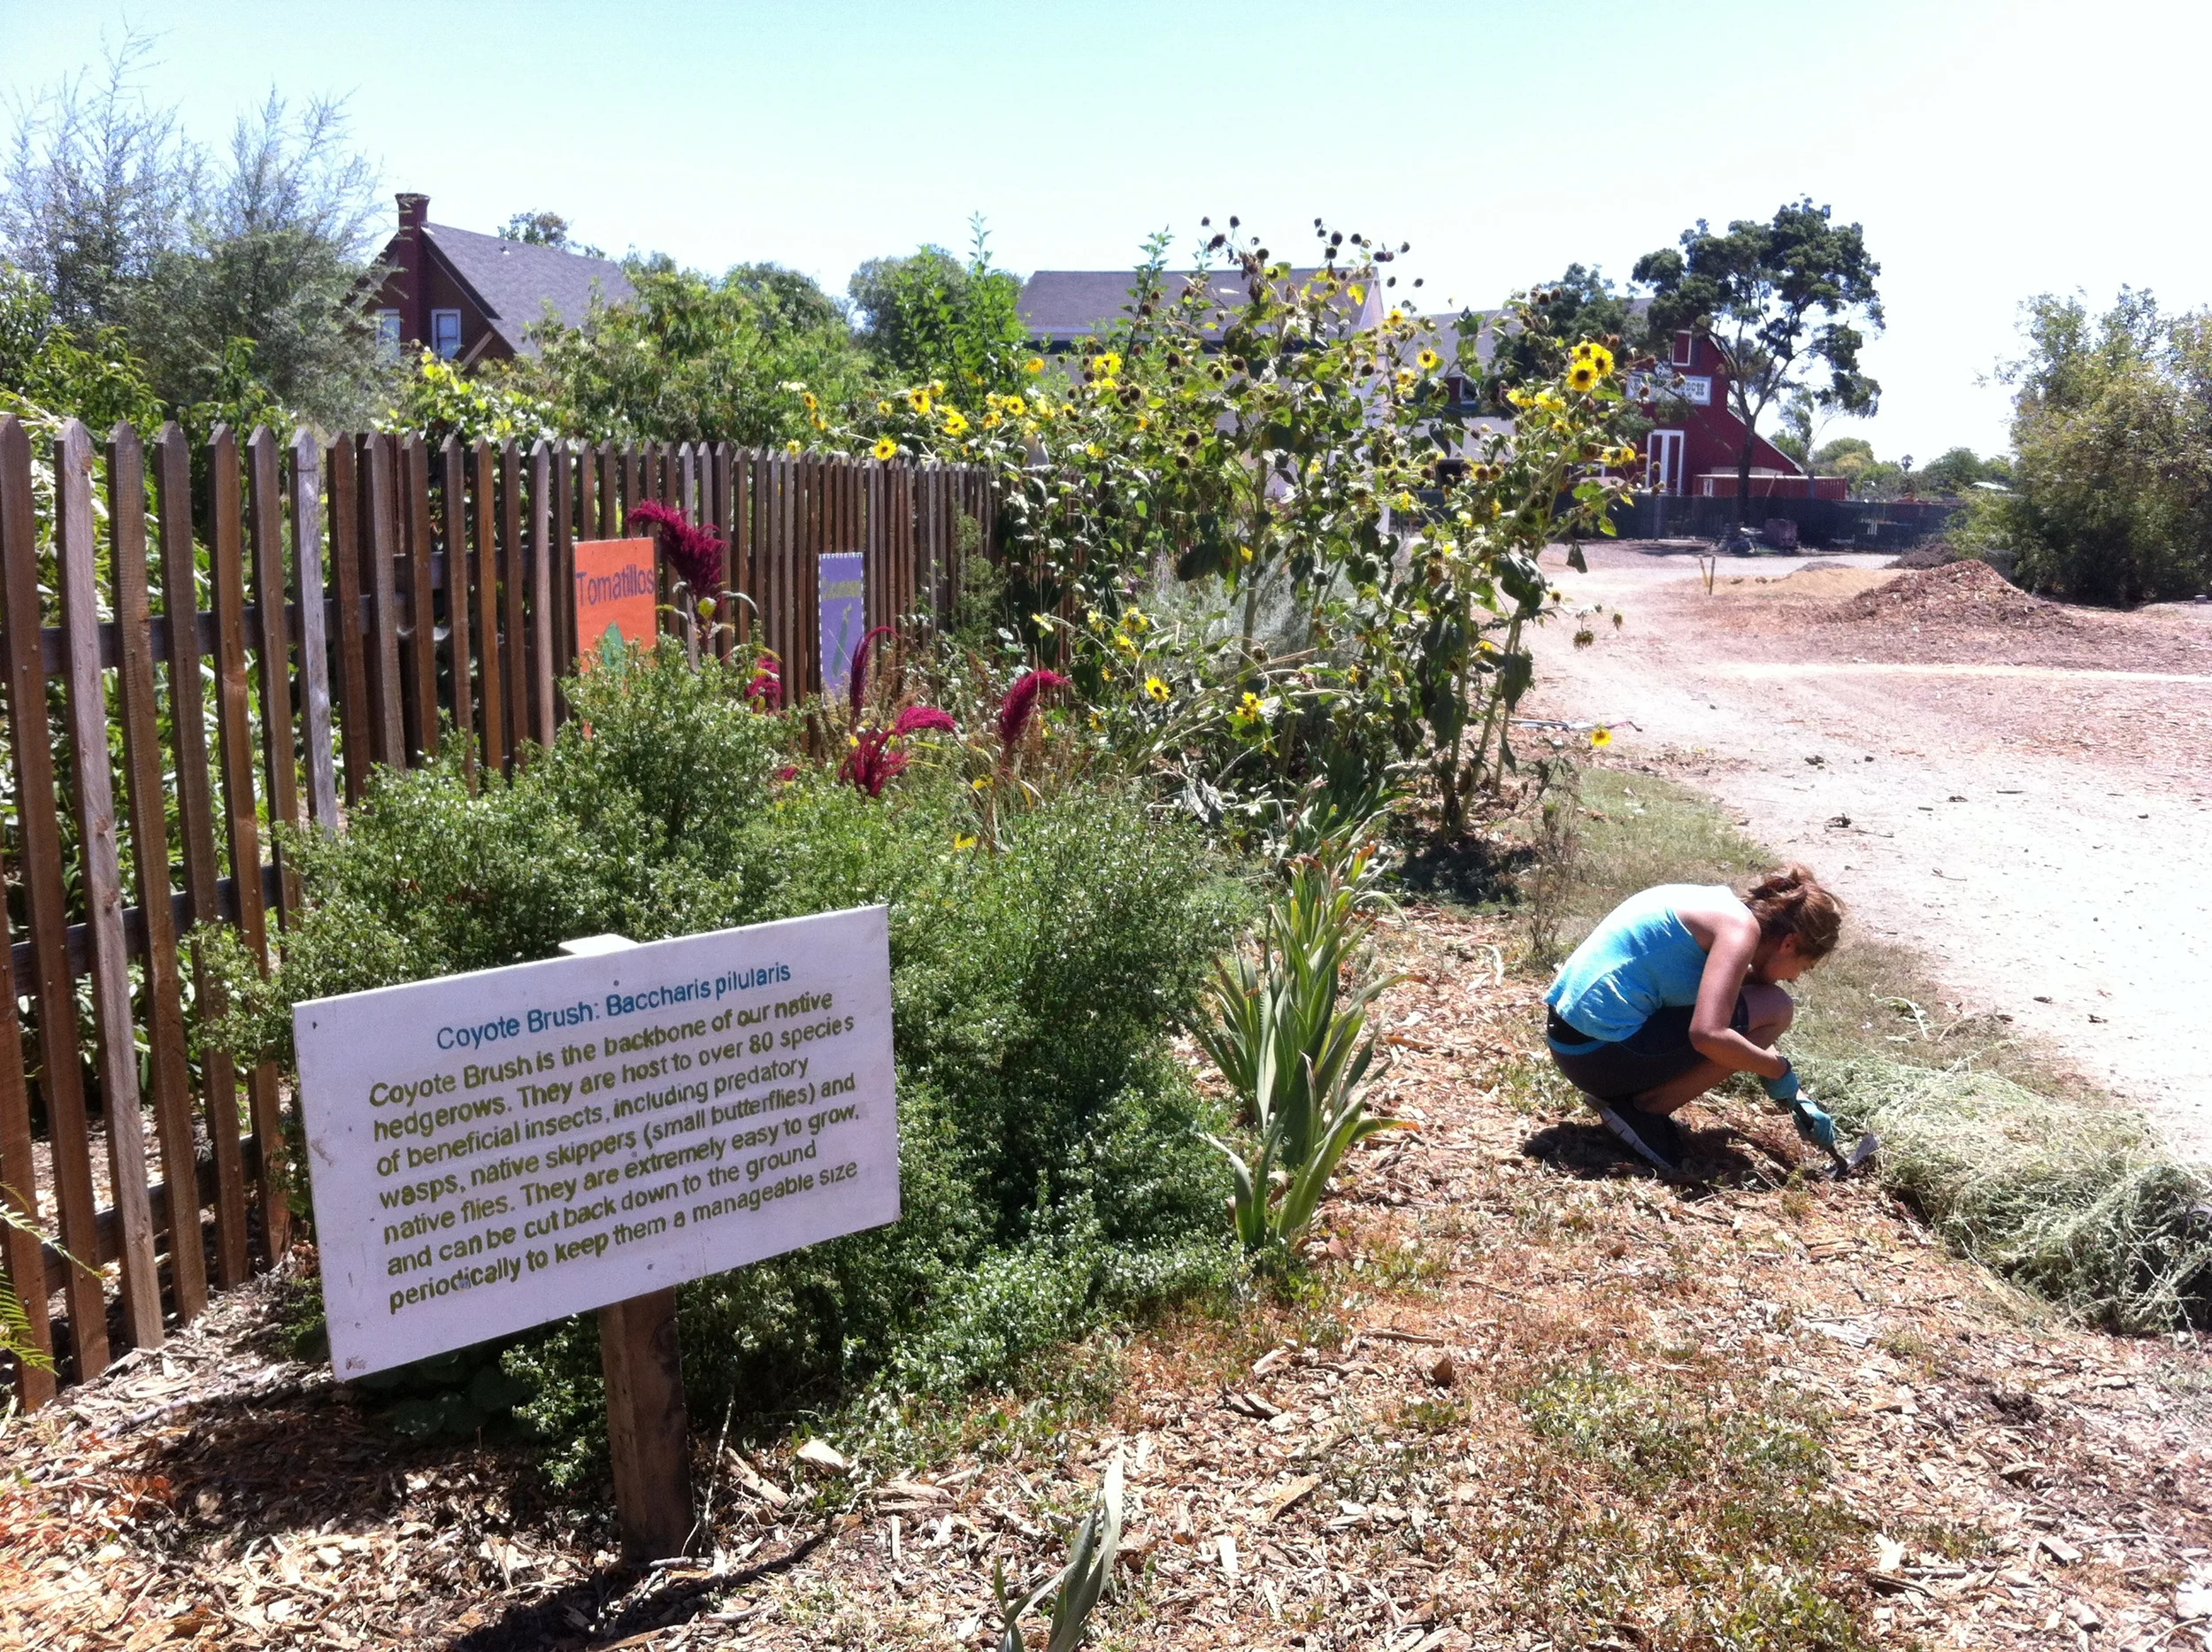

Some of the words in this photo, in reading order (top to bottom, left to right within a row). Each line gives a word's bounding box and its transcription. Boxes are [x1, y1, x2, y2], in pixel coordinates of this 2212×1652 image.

[575, 564, 655, 606] Tomatillos
[369, 1073, 457, 1107] Coyote
[464, 1056, 533, 1089] Brush
[536, 1050, 555, 1072] is
[561, 1044, 596, 1067] the
[604, 1019, 706, 1057] backbone
[711, 1009, 733, 1032] of
[737, 1004, 771, 1026] our
[774, 991, 833, 1018] native
[437, 1016, 520, 1049] Coyote
[527, 1002, 600, 1033] Brush:
[606, 979, 711, 1017] Baccharis
[715, 962, 791, 1001] pilularis
[374, 1095, 511, 1141] hedgerows.
[517, 1081, 572, 1108] They
[580, 1072, 615, 1095] are
[622, 1057, 668, 1083] host
[672, 1053, 692, 1072] to
[699, 1041, 743, 1066] over
[749, 1031, 773, 1054] 80
[780, 1016, 854, 1049] species
[376, 1149, 400, 1176] of
[407, 1121, 520, 1168] beneficial
[525, 1105, 610, 1140] insects,
[613, 1081, 708, 1118] including
[714, 1057, 809, 1097] predatory
[379, 1174, 465, 1209] wasps,
[471, 1155, 540, 1187] native
[545, 1129, 637, 1169] skippers
[643, 1108, 705, 1149] (small
[711, 1082, 815, 1126] butterflies)
[821, 1072, 856, 1097] and
[383, 1210, 455, 1245] native
[461, 1195, 516, 1224] flies.
[519, 1178, 577, 1206] They
[583, 1167, 618, 1191] are
[625, 1136, 726, 1179] extremely
[732, 1124, 779, 1150] easy
[782, 1118, 802, 1136] to
[808, 1104, 860, 1135] grow.
[388, 1245, 433, 1276] and
[439, 1234, 482, 1261] can
[487, 1226, 517, 1249] be
[524, 1210, 560, 1239] cut
[563, 1195, 618, 1228] back
[621, 1182, 679, 1211] down
[681, 1174, 701, 1195] to
[708, 1165, 740, 1187] the
[746, 1139, 817, 1182] ground
[389, 1256, 521, 1315] periodically
[526, 1249, 549, 1272] to
[554, 1232, 609, 1264] keep
[612, 1215, 666, 1245] them
[673, 1210, 686, 1227] a
[693, 1174, 814, 1223] manageable
[819, 1161, 858, 1186] size
